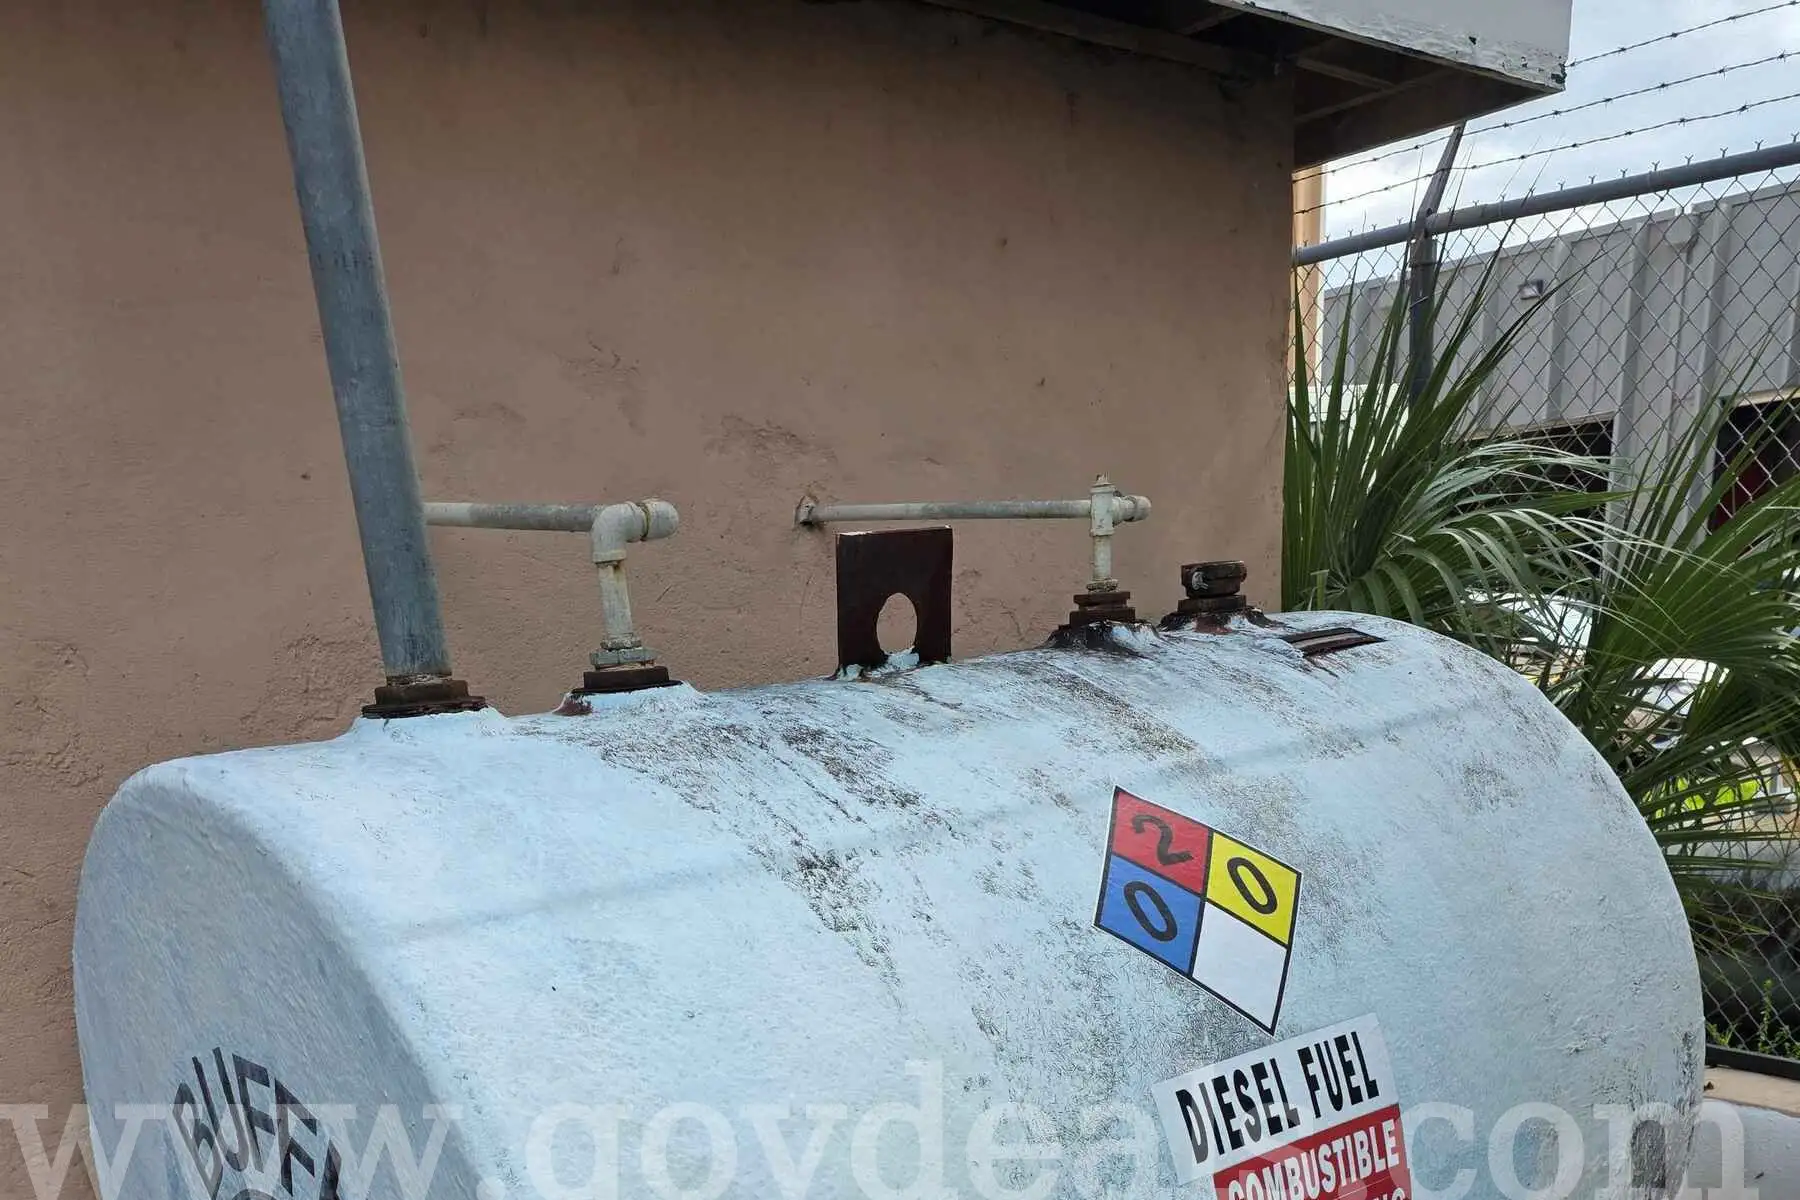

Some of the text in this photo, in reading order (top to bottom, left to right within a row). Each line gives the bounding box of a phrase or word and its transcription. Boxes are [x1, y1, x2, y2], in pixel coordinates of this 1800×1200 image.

[1132, 814, 1194, 865] 2
[1123, 880, 1178, 943] 0
[1227, 857, 1278, 916] 0
[1175, 1031, 1380, 1164] DIESEL FUEL
